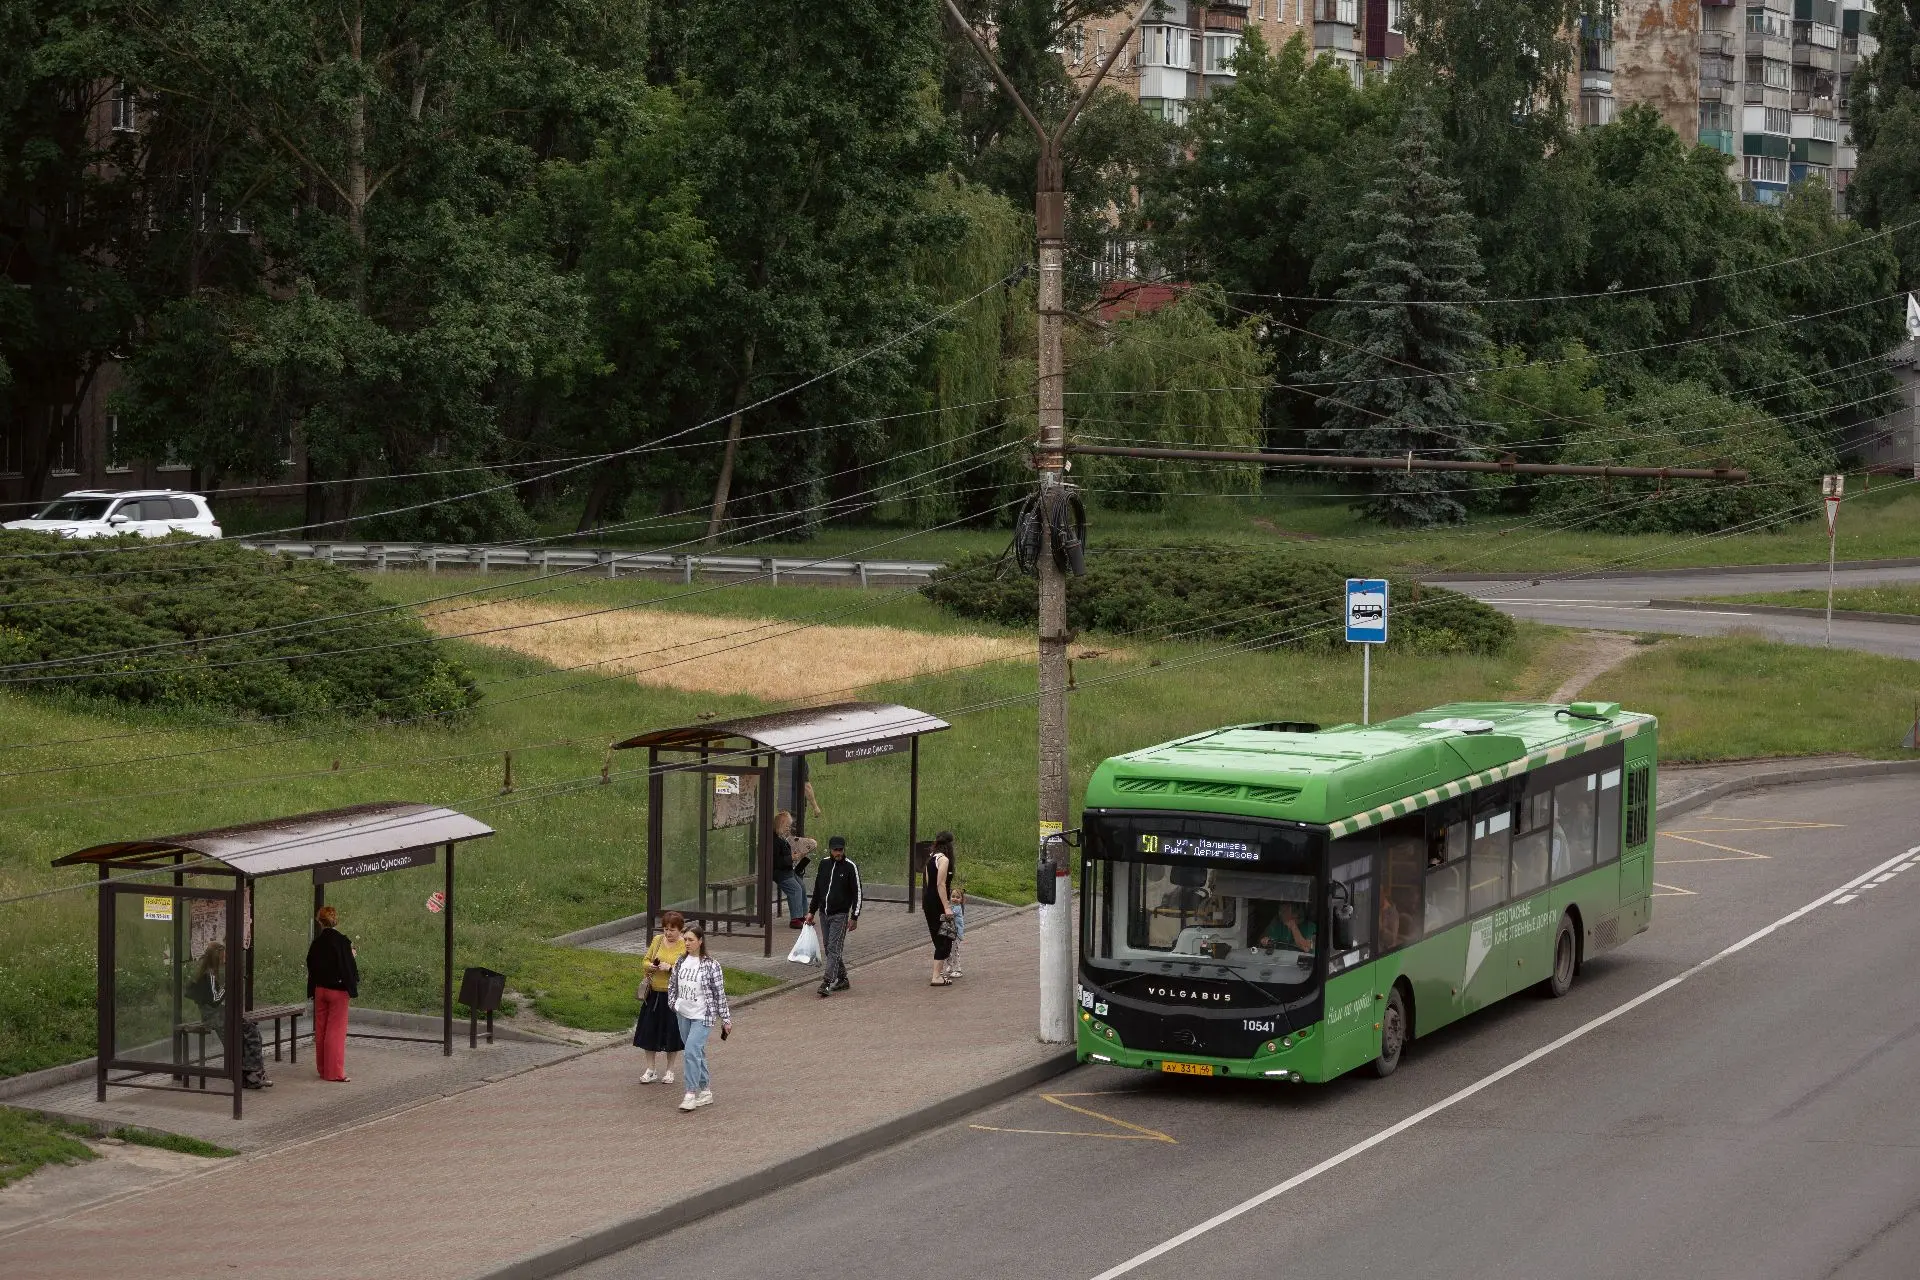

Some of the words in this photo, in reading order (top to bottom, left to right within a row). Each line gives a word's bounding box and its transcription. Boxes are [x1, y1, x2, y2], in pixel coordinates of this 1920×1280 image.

[1142, 834, 1158, 853] 50
[1164, 844, 1187, 855] Рын.
[1176, 839, 1193, 847] ул.
[1199, 838, 1247, 851] Малышева
[340, 866, 355, 876] Ост.
[355, 862, 380, 873] «Улица
[1495, 901, 1531, 928] БЕЗОПАСНЫЕ
[1148, 987, 1231, 1002] VOLGABUS
[1242, 1019, 1275, 1033] 10541
[1180, 1064, 1196, 1074] 331
